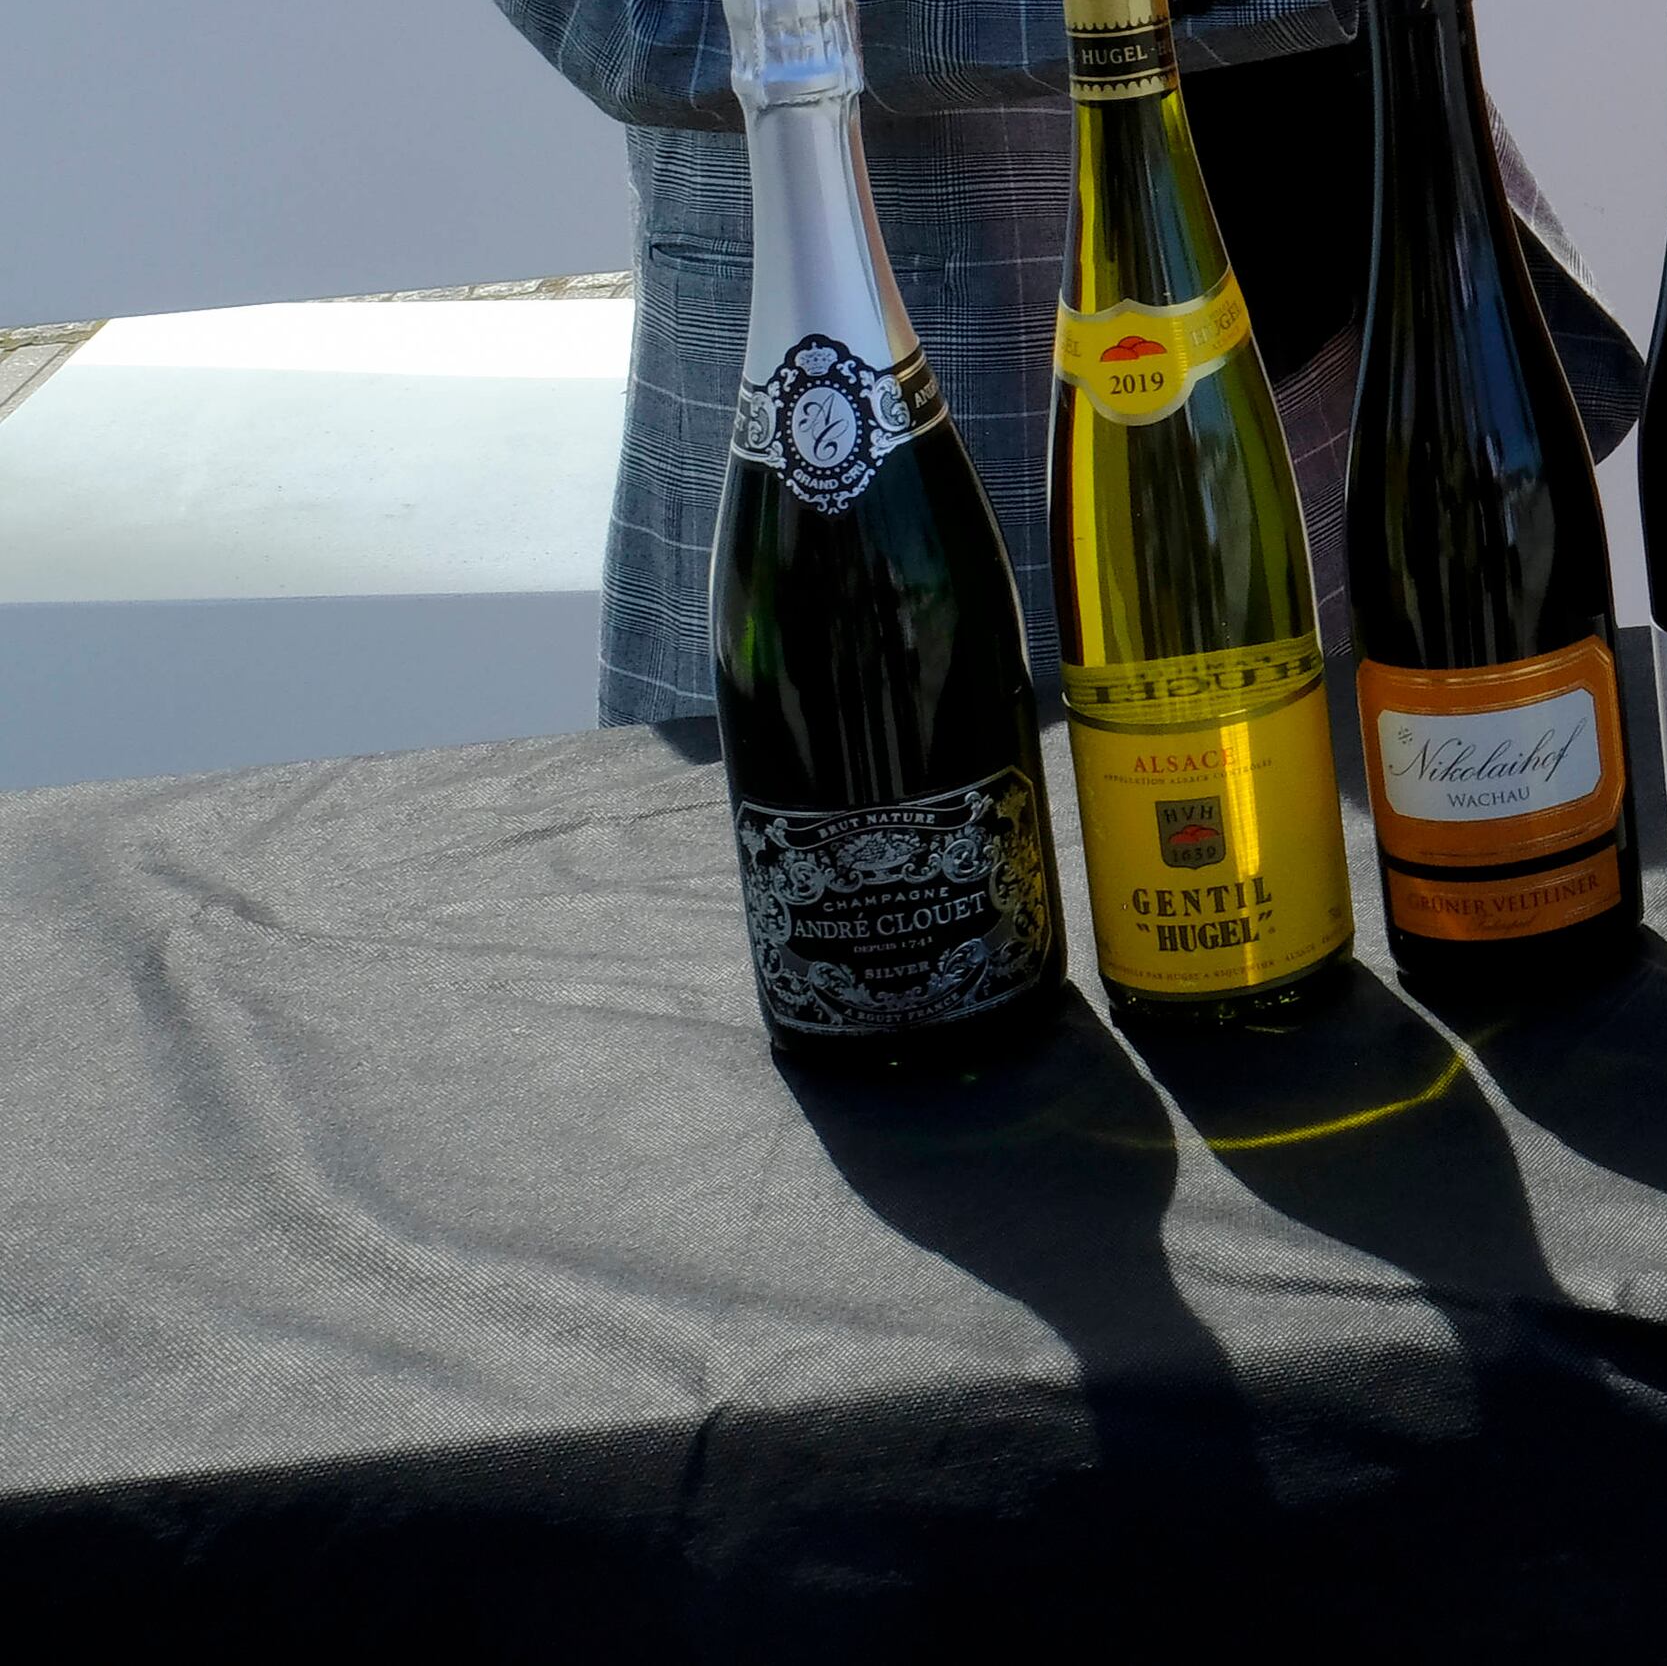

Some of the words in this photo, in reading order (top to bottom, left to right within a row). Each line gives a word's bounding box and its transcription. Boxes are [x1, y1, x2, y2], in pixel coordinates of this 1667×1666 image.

[1081, 45, 1148, 65] HUGEL
[1110, 371, 1165, 395] 2019
[793, 469, 838, 491] GRAND
[841, 460, 867, 485] CRU
[1134, 747, 1236, 774] ALSACE
[1389, 716, 1588, 783] Nikolaihof
[1447, 786, 1531, 808] WACHAU
[818, 818, 859, 839] BRUT
[866, 813, 936, 825] NATURE
[823, 887, 950, 912] CHAMPAGNE
[1132, 877, 1273, 917] GENTIL
[1493, 874, 1599, 913] VELTLINER
[794, 912, 870, 939] ANDRÉ
[877, 891, 987, 936] CLOUET
[854, 943, 897, 954] DEPUIS
[901, 936, 933, 948] 1741
[864, 960, 930, 980] SILVER
